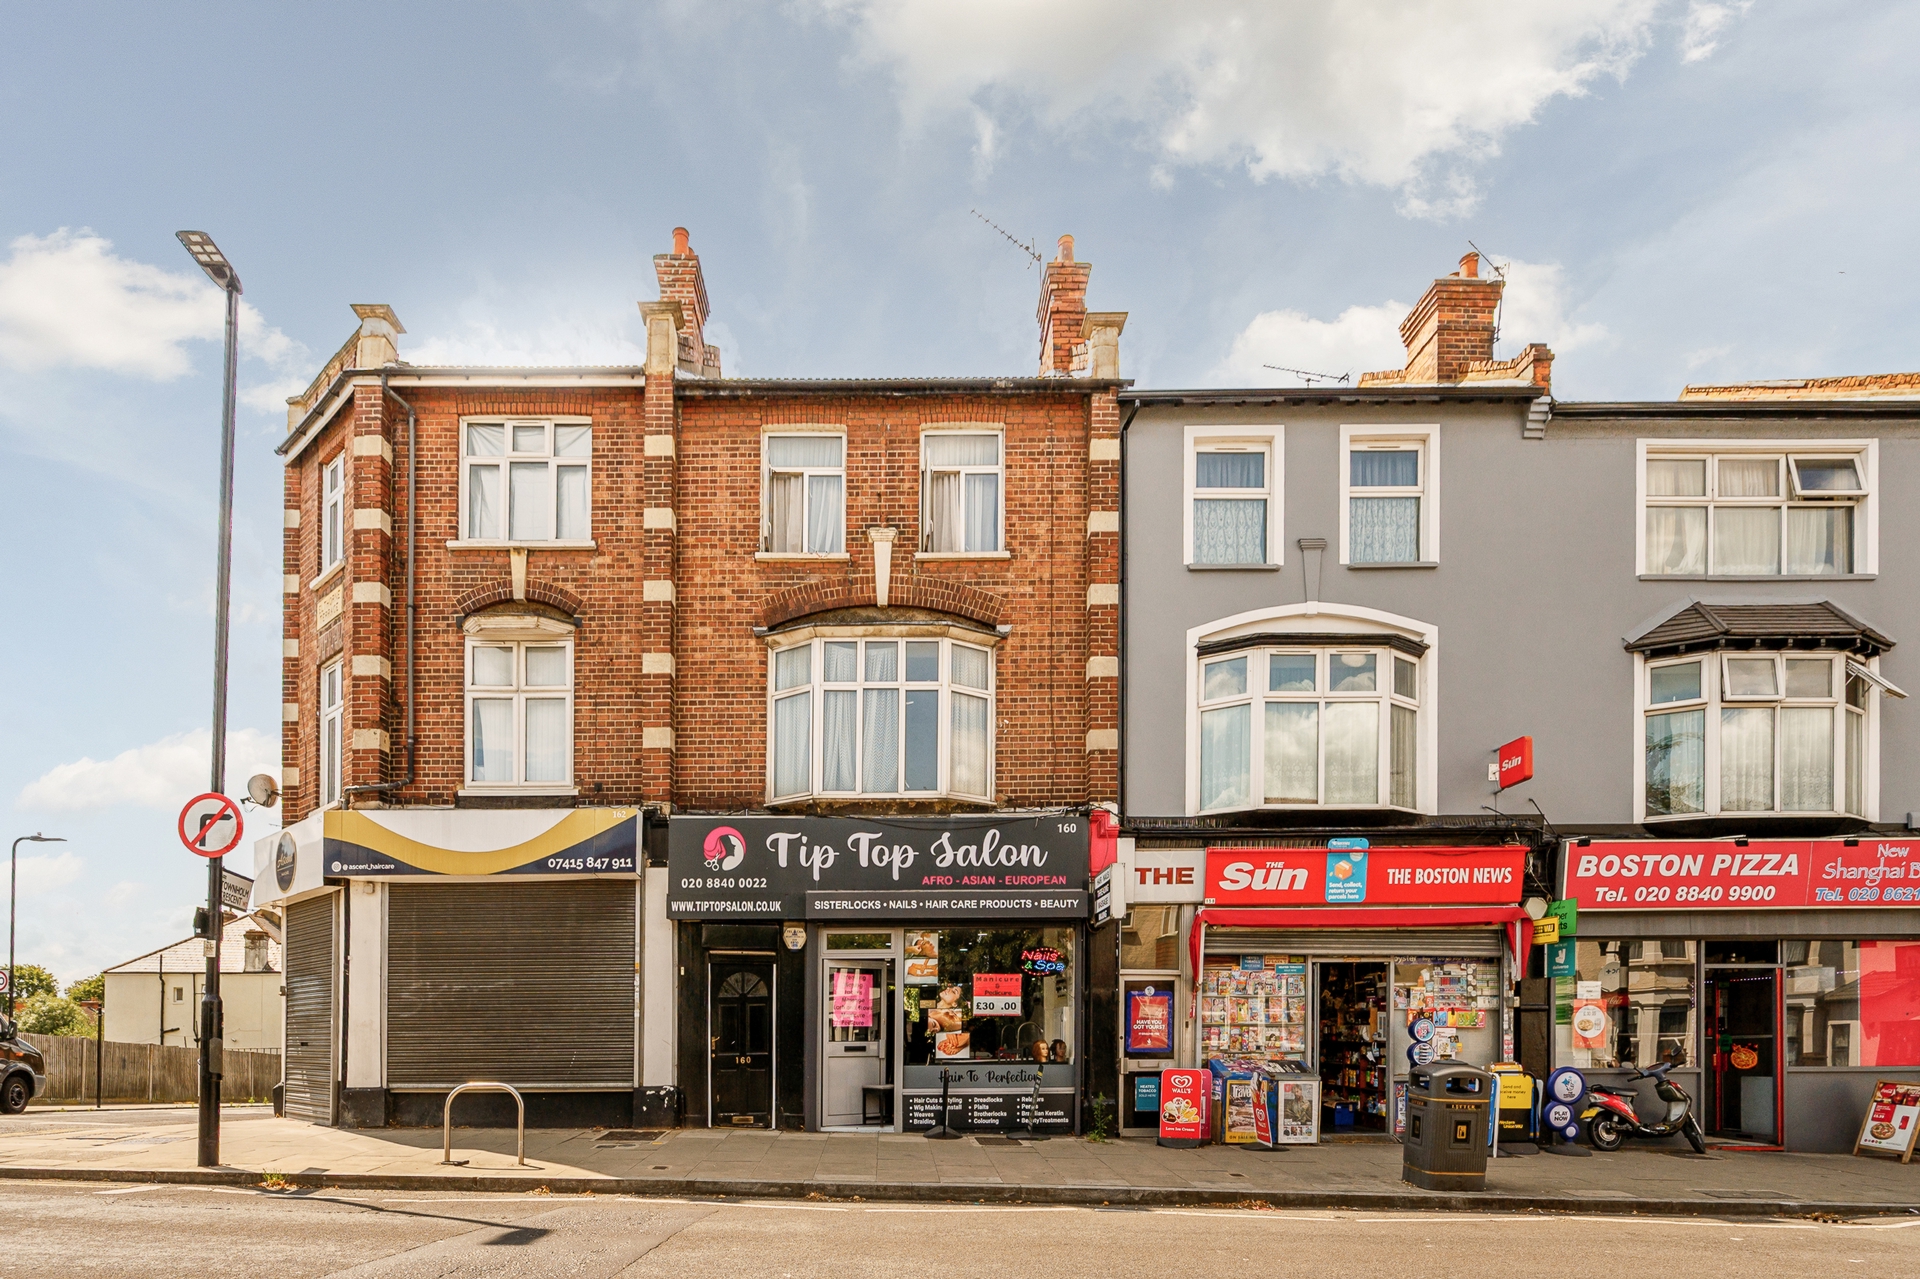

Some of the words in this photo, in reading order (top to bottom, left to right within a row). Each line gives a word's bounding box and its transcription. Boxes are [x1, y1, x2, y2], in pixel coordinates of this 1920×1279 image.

[1501, 756, 1522, 772] Sun
[612, 810, 626, 818] 162
[1057, 824, 1077, 833] 160
[766, 832, 840, 881] Tip
[847, 832, 919, 881] Top
[930, 828, 1048, 868] Salon
[1877, 843, 1910, 858] New
[548, 858, 583, 869] 07415
[586, 857, 609, 868] 847
[612, 857, 633, 869] 911
[1576, 854, 1704, 877] BOSTON
[1710, 854, 1798, 876] PIZZA
[1134, 867, 1194, 885] THE
[1218, 862, 1308, 891] Sun
[1387, 868, 1411, 884] THE
[1415, 868, 1470, 884] BOSTON
[1473, 867, 1512, 884] NEWS
[1822, 857, 1906, 887] Shanghai
[681, 878, 703, 888] 020
[706, 878, 735, 888] 8840
[738, 878, 767, 888] 0022
[922, 876, 953, 885] AFRO
[962, 876, 996, 885] ASIAN
[1005, 876, 1067, 885] EUROPEAN
[1595, 887, 1627, 902] Tel.
[1634, 886, 1670, 902] 020
[1675, 886, 1723, 901] 8840
[1728, 886, 1775, 901] 9900
[1815, 887, 1844, 901] Tel.
[1848, 887, 1880, 901] 020
[671, 900, 782, 912] WWW.TIPTOPSALON.CO.UK
[814, 900, 881, 910] SISTERLOCKS
[889, 900, 917, 909] NAILS
[925, 900, 949, 909] HAIR
[950, 900, 978, 909] CARE
[980, 900, 1032, 909] PRODUCTS
[1040, 899, 1079, 909] BEAUTY
[1021, 950, 1058, 961] Nails
[1025, 961, 1032, 969] &
[1034, 960, 1065, 972] Spa
[976, 1002, 994, 1010] £30
[1001, 1002, 1017, 1010] .00
[735, 1056, 751, 1064] 160
[966, 1070, 979, 1082] To
